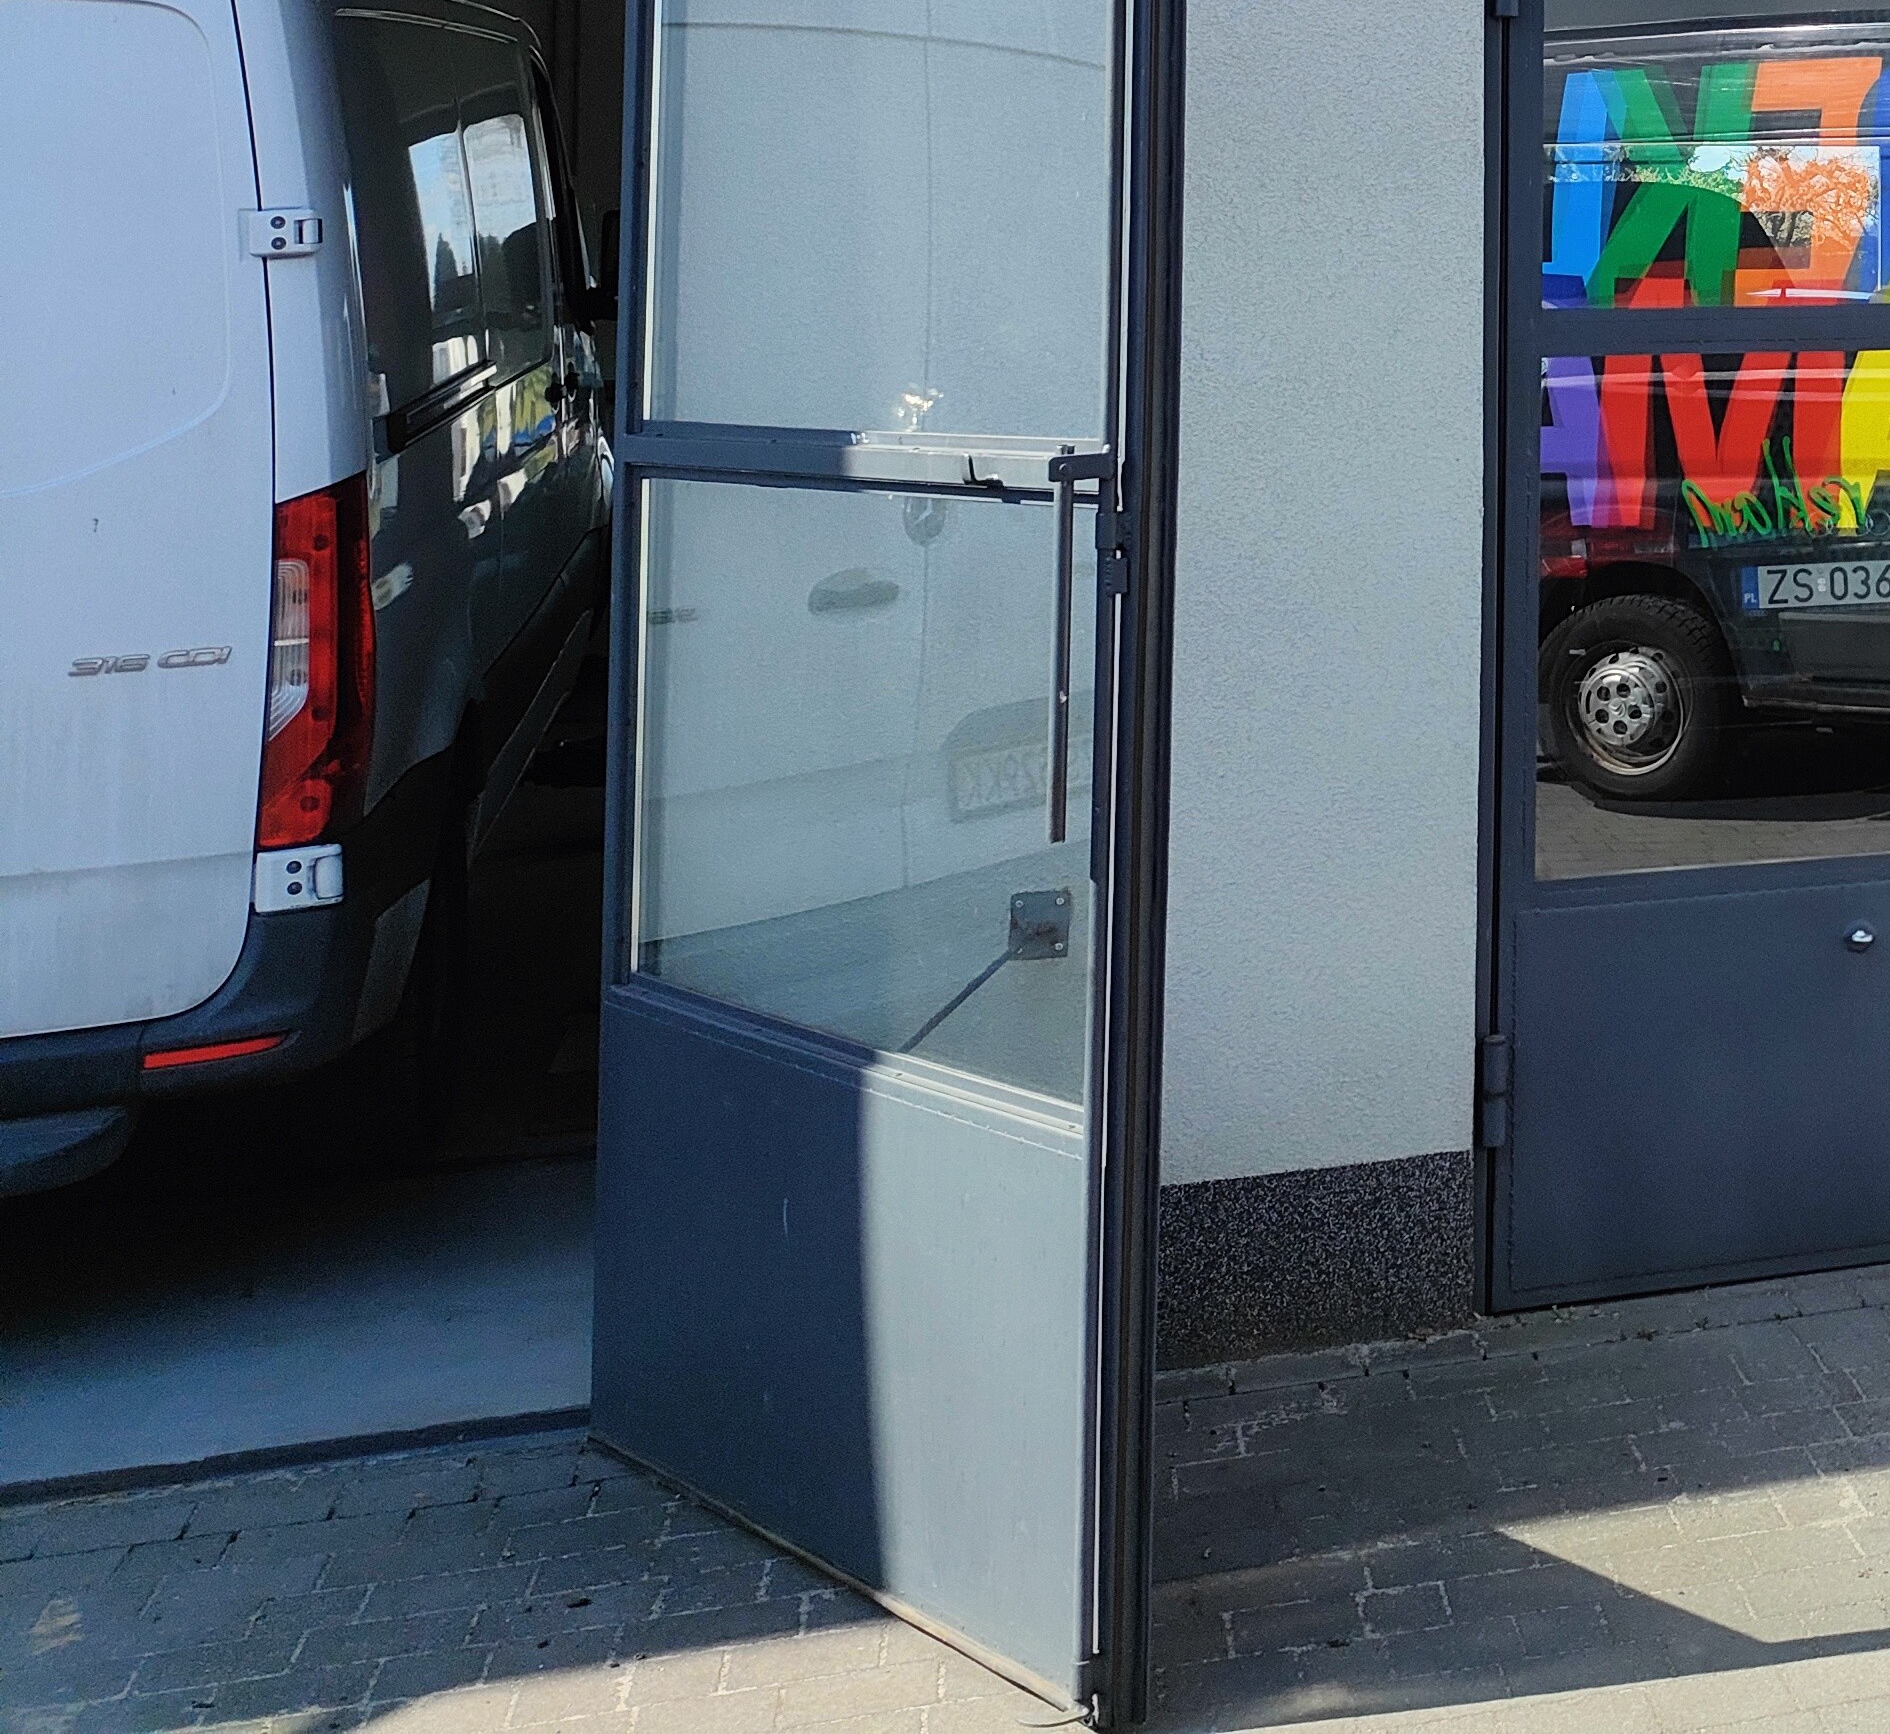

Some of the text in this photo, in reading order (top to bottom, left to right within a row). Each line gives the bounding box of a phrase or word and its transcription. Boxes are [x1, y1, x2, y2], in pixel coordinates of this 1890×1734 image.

[1743, 592, 1757, 604] PL
[1766, 567, 1815, 605] ZS
[156, 645, 233, 670] CDI
